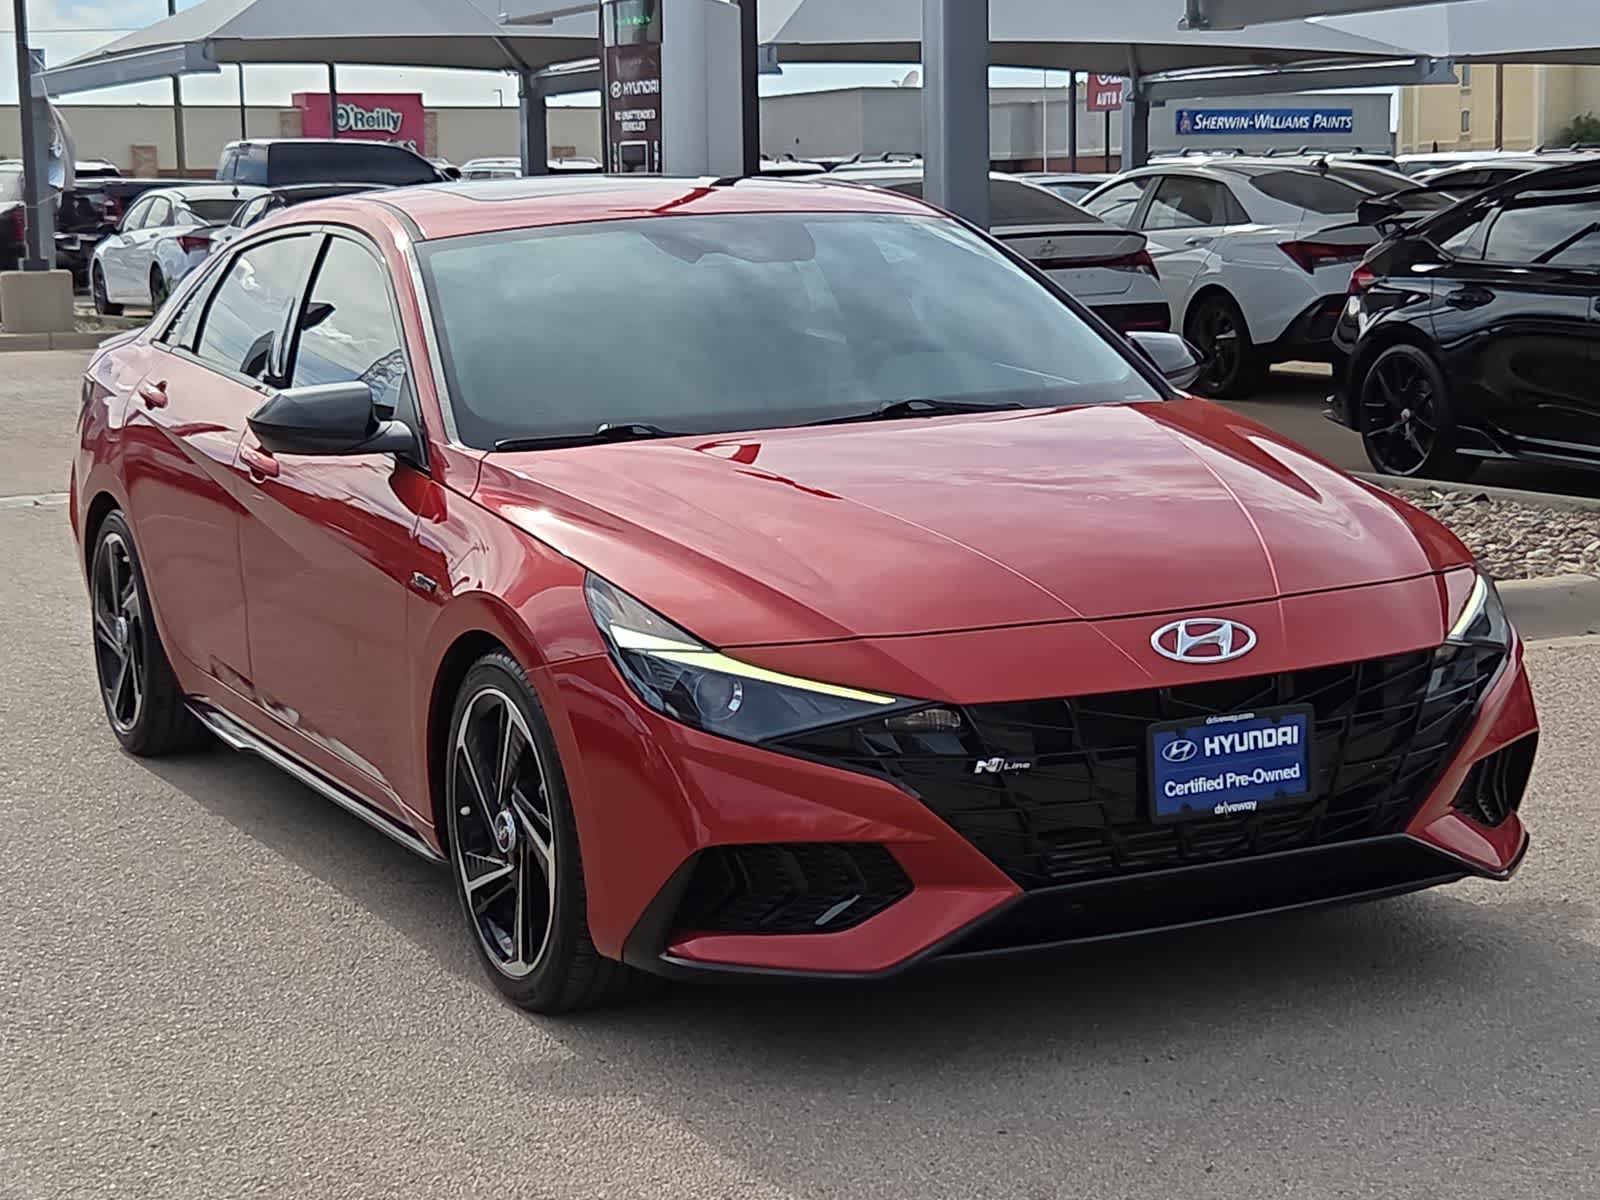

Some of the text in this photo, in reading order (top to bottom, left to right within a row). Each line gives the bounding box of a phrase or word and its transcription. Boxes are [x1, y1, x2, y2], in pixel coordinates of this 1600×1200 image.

[623, 80, 659, 95] HYUNDAI
[1096, 91, 1117, 105] AUTO
[337, 104, 402, 133] O'Reilly
[1312, 115, 1352, 129] PAINTS
[1204, 725, 1299, 757] HYUNDAI
[1164, 762, 1301, 797] Certified Pre-Owned
